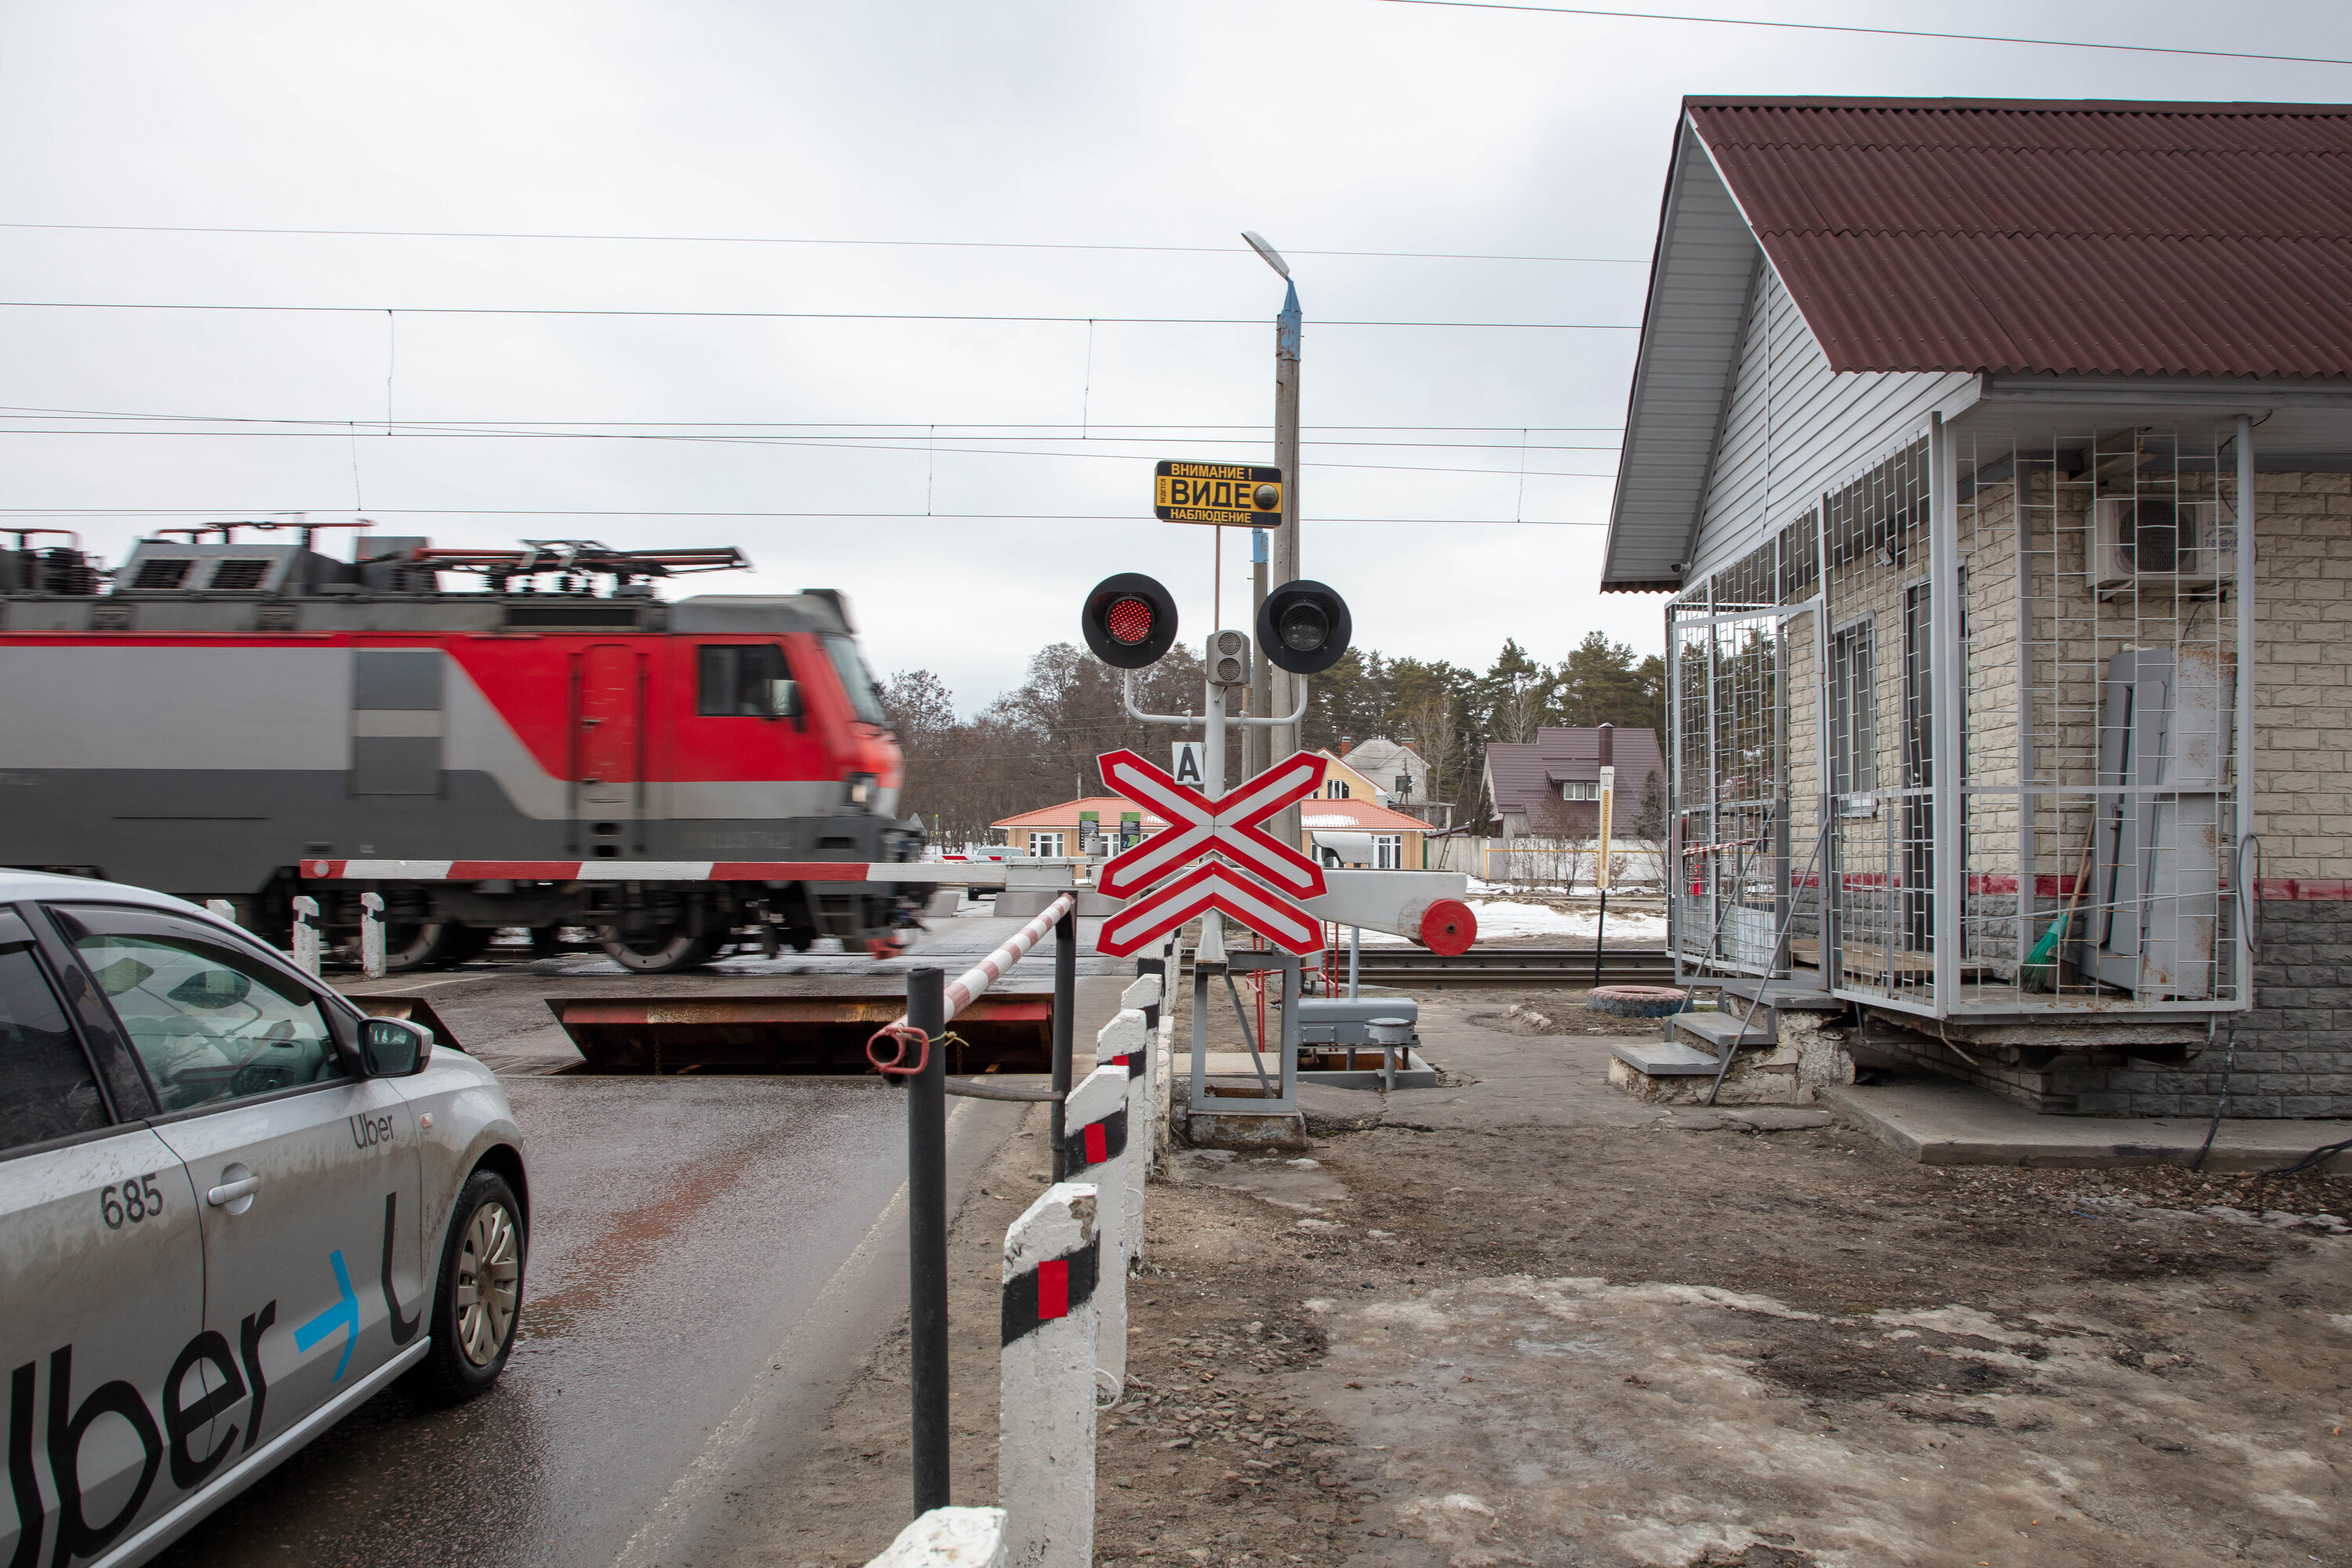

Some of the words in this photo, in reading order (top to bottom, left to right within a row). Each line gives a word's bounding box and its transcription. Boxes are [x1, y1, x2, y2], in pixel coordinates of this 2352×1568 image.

[1171, 463, 1245, 480] ВНИМАНИЕ
[1171, 479, 1279, 510] ВИДЕ
[1170, 508, 1252, 524] НАБЛЮДЕНИЕ
[1176, 746, 1201, 782] А
[349, 1112, 394, 1149] Uber
[100, 1172, 163, 1230] 685
